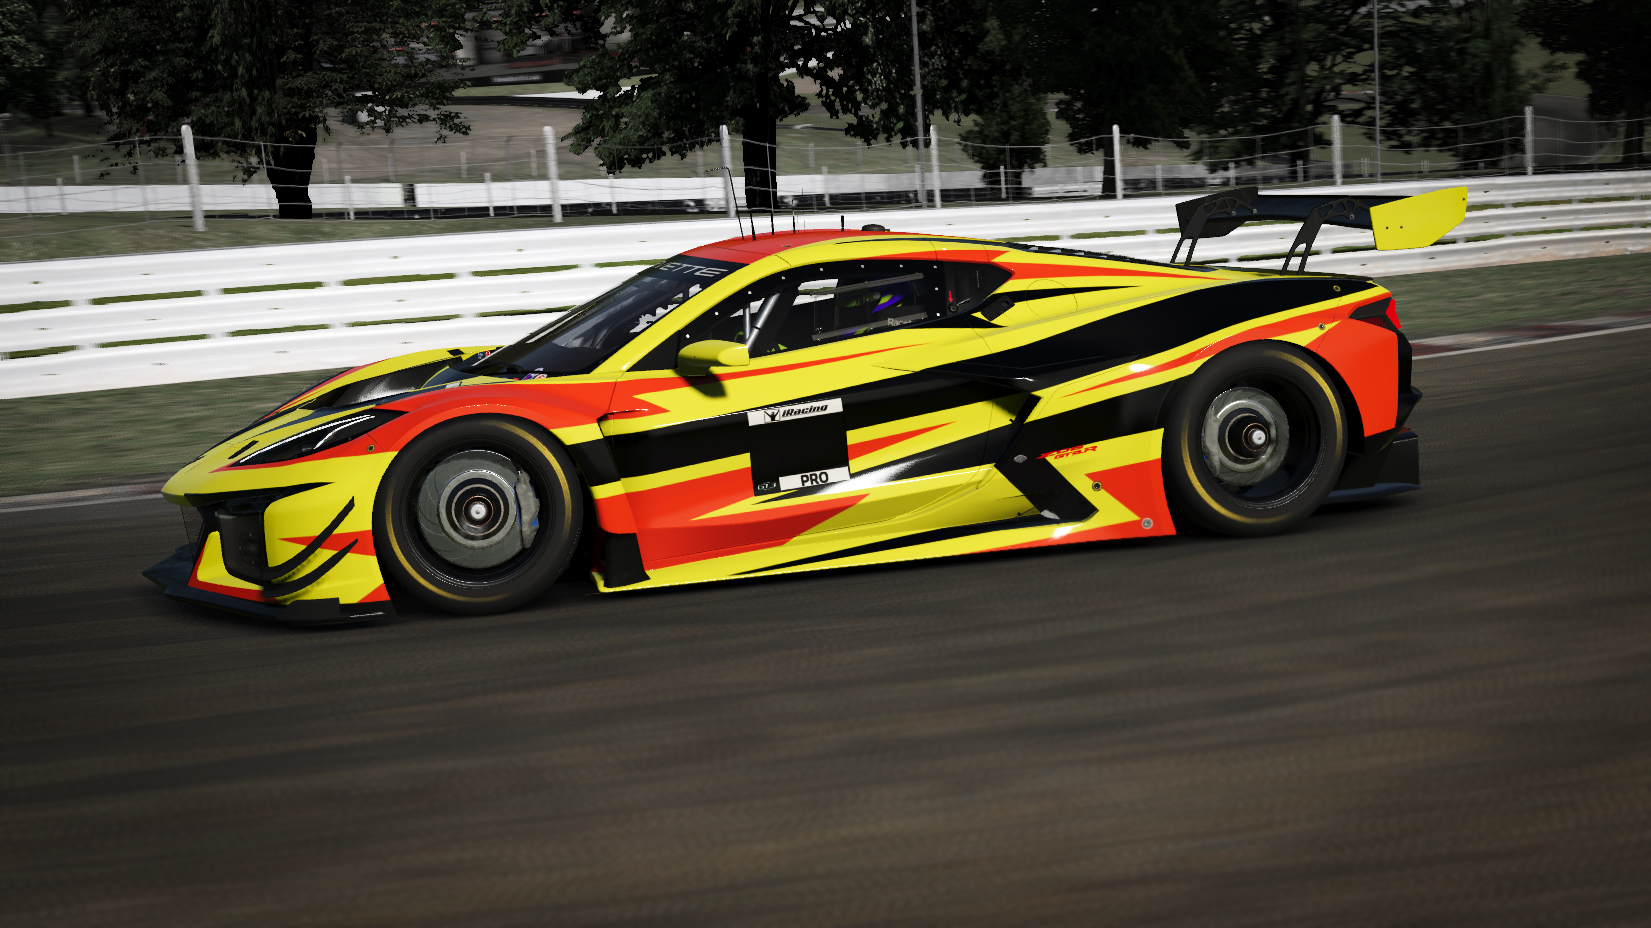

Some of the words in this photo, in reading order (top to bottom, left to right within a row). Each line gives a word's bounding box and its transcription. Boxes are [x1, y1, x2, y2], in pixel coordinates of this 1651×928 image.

[655, 261, 729, 277] ETTE
[781, 404, 829, 418] iRacing
[757, 481, 777, 491] GT3
[800, 471, 829, 487] PRO
